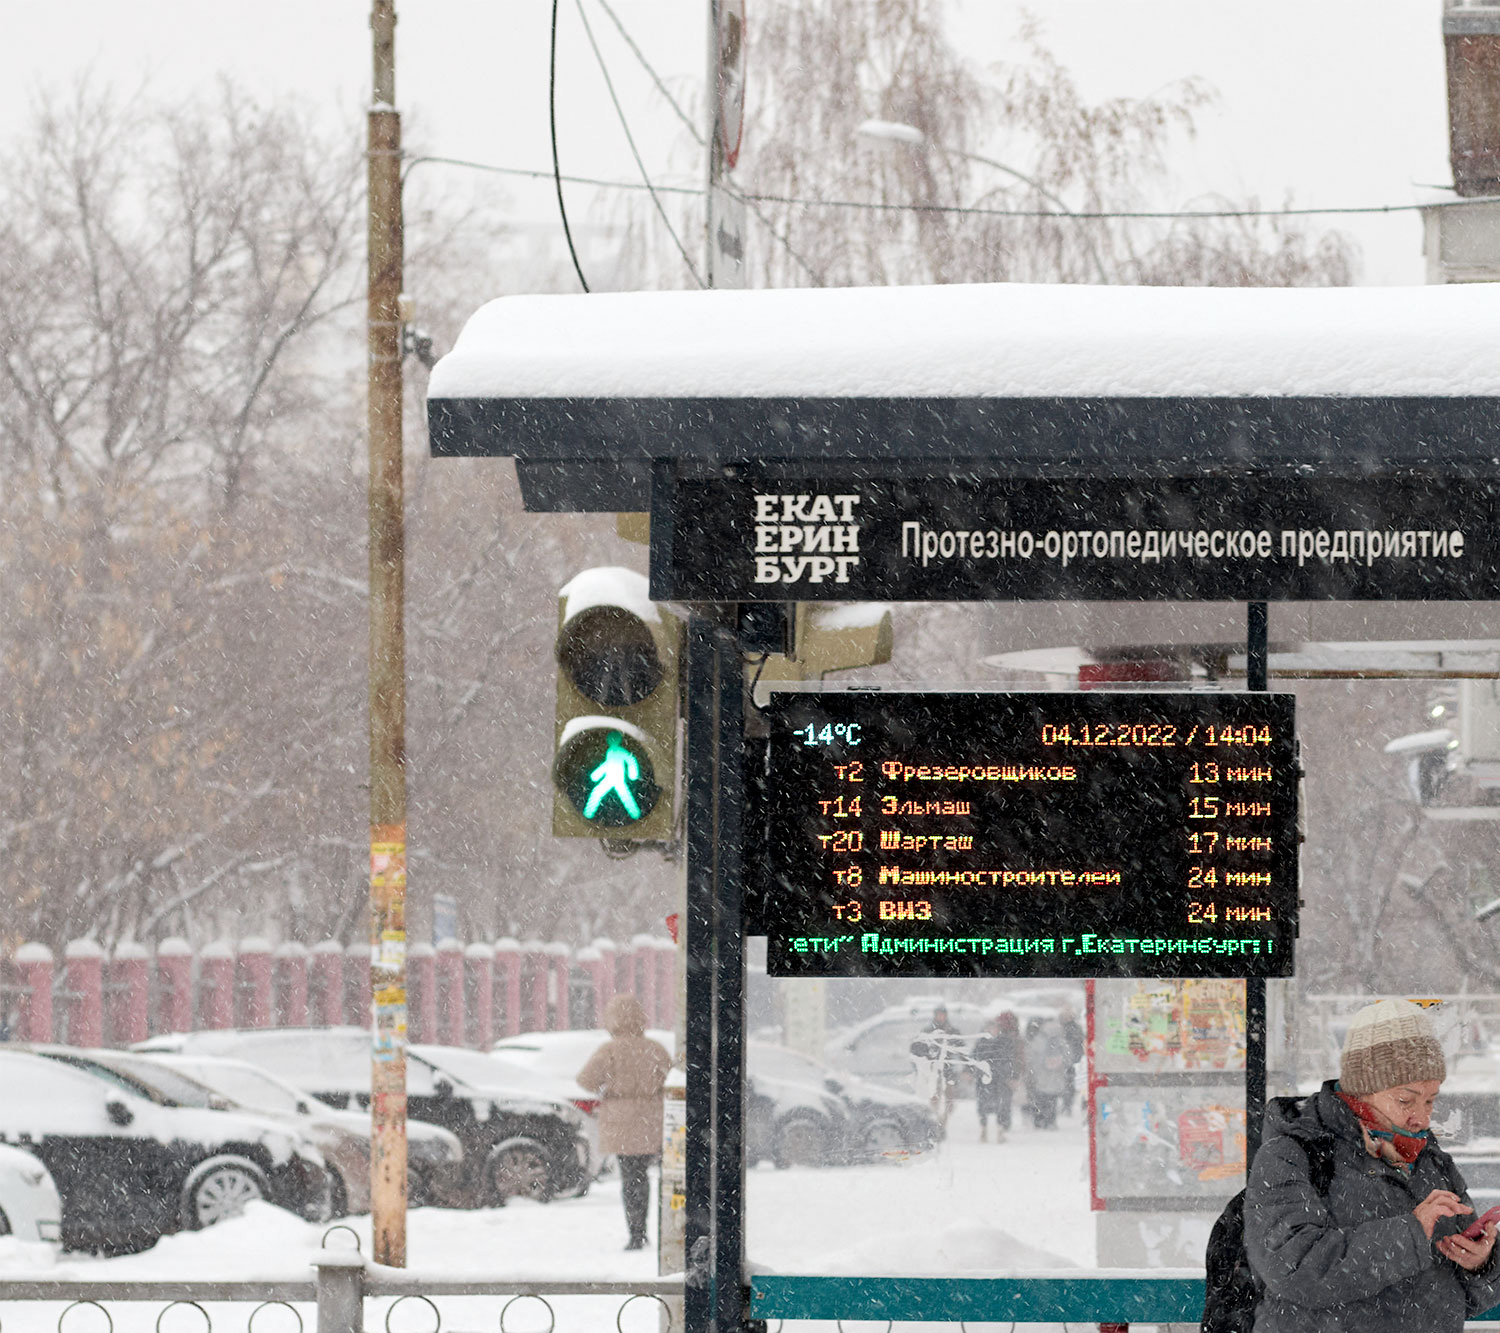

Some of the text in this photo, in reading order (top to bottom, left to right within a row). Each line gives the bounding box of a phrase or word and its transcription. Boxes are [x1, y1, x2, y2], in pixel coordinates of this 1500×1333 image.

[754, 495, 859, 521] ЕКАТ
[754, 525, 859, 553] ЕРИН
[902, 522, 1464, 566] Протезно-ортопедическое предприятие
[754, 555, 859, 583] БУРГ
[1041, 724, 1176, 746] 04.12.2022
[1205, 724, 1272, 746] 14:04
[882, 762, 1077, 782] Фрезеровщиков
[1191, 763, 1219, 783] 13
[1227, 767, 1272, 781] мин
[881, 796, 971, 815] Эльмаш
[1189, 798, 1219, 818] 15
[1226, 802, 1271, 816] мин
[880, 831, 973, 852] Шарташ
[1189, 833, 1219, 853] 17
[1226, 838, 1271, 852] мин
[879, 866, 1120, 885] Машиностроителей
[1188, 868, 1218, 888] 24
[1226, 873, 1271, 885] мин
[880, 901, 932, 920] ВИЗ
[1188, 903, 1217, 923] 24
[1226, 907, 1271, 921] мин
[861, 934, 1055, 955] Администрация
